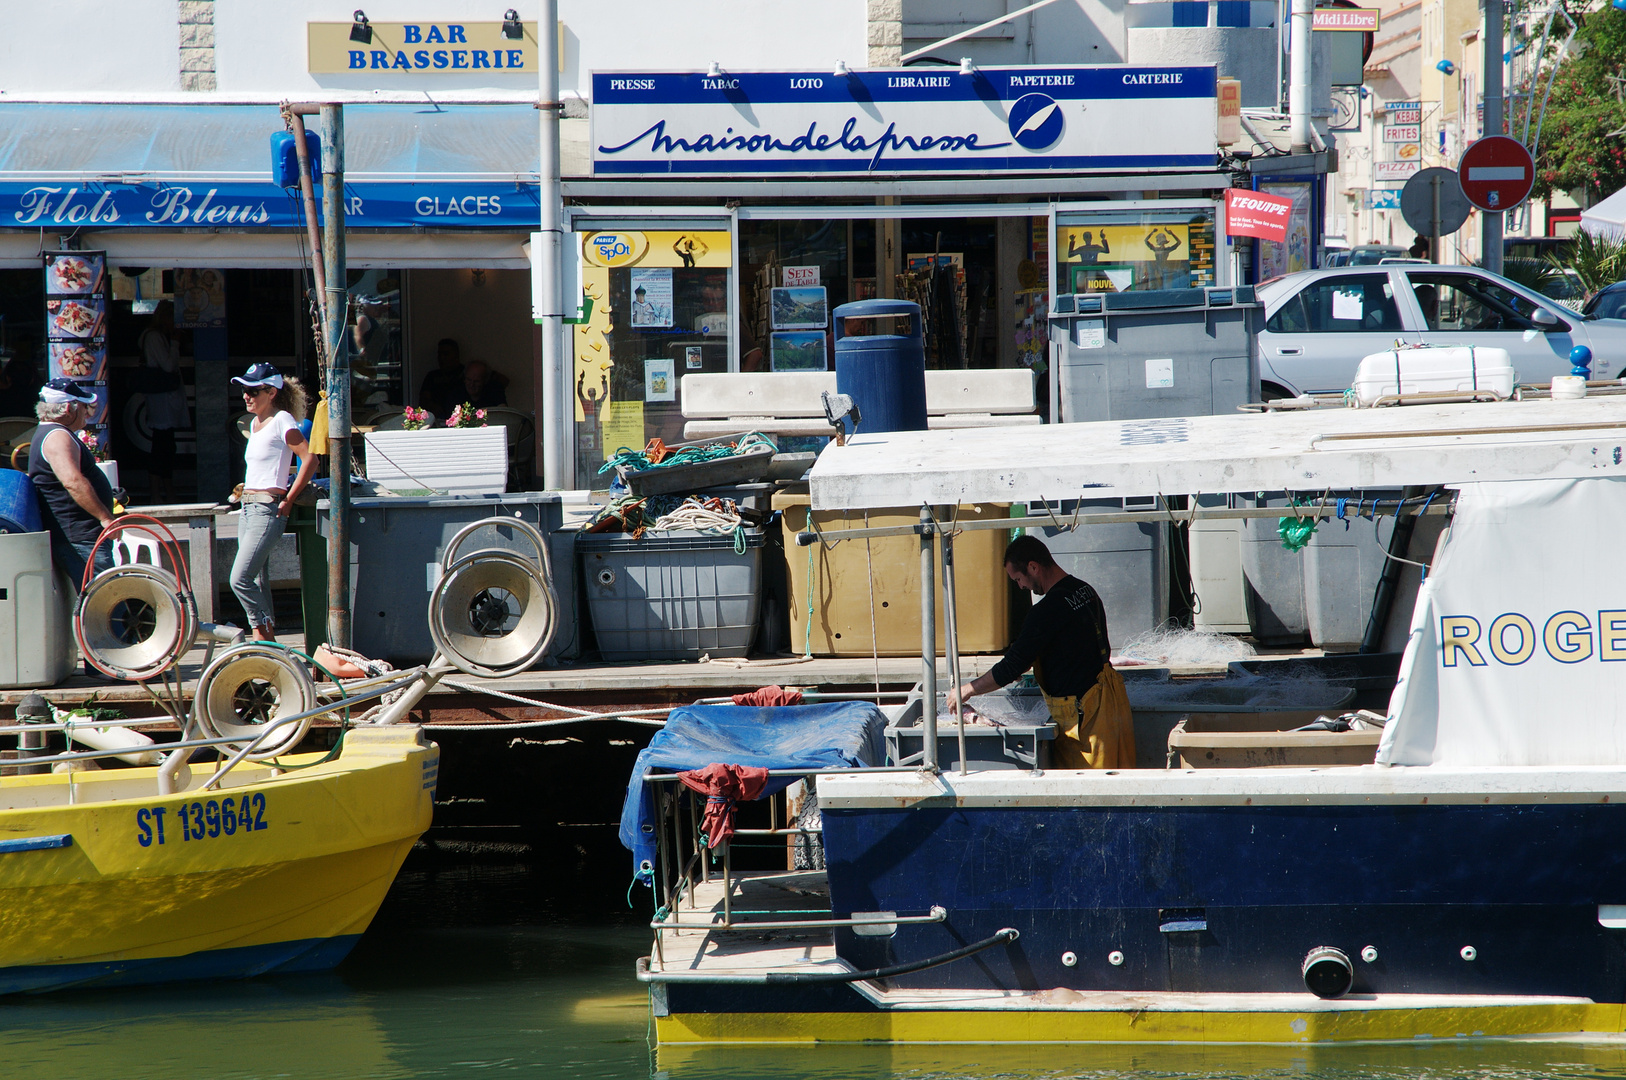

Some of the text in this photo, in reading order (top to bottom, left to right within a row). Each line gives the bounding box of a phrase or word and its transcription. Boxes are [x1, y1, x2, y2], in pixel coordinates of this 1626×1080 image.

[1313, 13, 1375, 25] Midi Libre
[403, 25, 467, 44] BAR
[348, 50, 524, 69] BRASSERIE
[610, 79, 656, 90] PRESSE
[701, 79, 740, 90] TABAC
[790, 78, 823, 89] LOTO
[887, 76, 951, 88] LIBRAIRIE
[1010, 75, 1075, 86] PAPETERIE
[1122, 73, 1183, 85] CARTERIE
[1385, 102, 1419, 110] LAVERIE
[1395, 110, 1420, 122] KEBAB
[1386, 128, 1418, 139] FRITES
[1378, 162, 1416, 172] PIZZA
[15, 186, 270, 223] Flots Bleus
[415, 195, 502, 216] GLACES
[1230, 196, 1289, 216] L'ÉQUIPE
[796, 278, 818, 287] TABLE
[1088, 279, 1115, 289] NOUVE
[1440, 610, 1626, 667] ROGE
[137, 793, 268, 847] ST 139642
